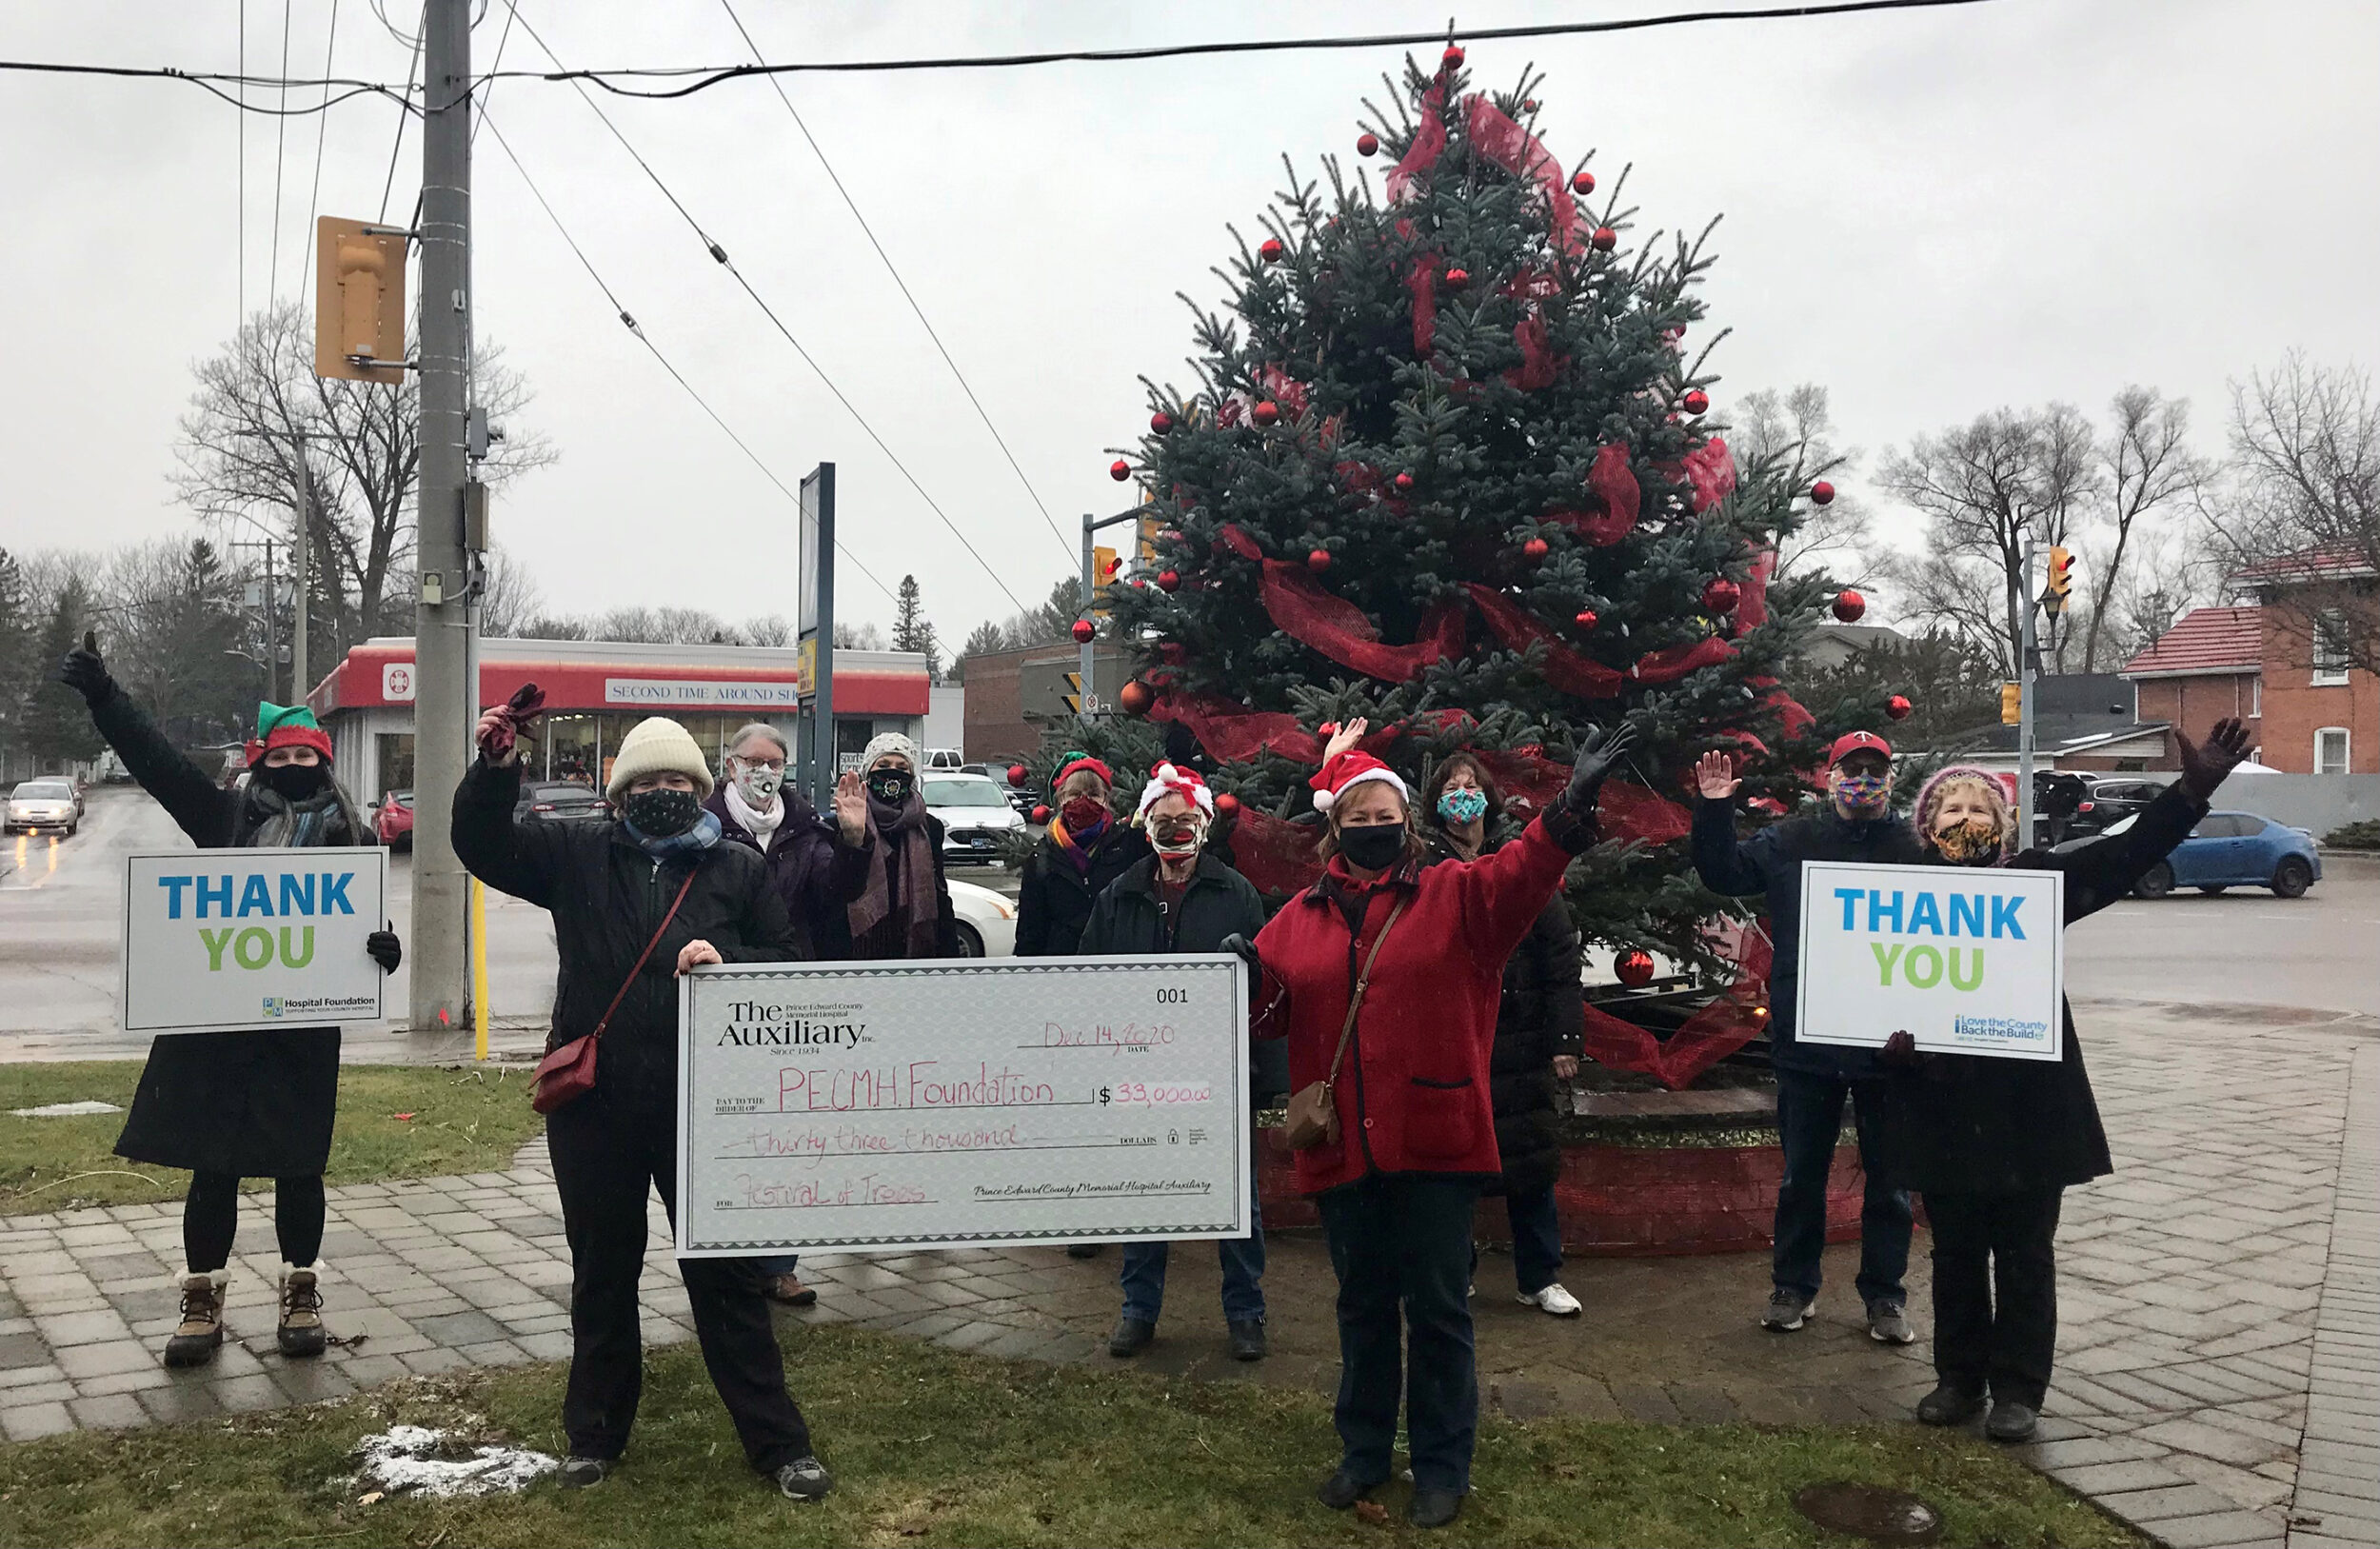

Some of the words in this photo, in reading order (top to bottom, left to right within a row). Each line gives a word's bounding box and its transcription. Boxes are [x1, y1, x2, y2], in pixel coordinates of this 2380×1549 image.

[612, 685, 671, 698] SECOND
[675, 687, 709, 699] TIME
[715, 688, 773, 701] AROUND
[158, 872, 355, 919] THANK
[1835, 887, 2027, 940] THANK
[198, 925, 314, 971] YOU
[1870, 942, 1984, 992] YOU
[285, 998, 323, 1008] Hospital
[324, 996, 375, 1006] Foundation
[1156, 988, 1188, 1003] 001
[728, 1001, 783, 1023] The
[839, 1003, 863, 1011] County
[717, 1020, 866, 1050] Auxiliary
[1045, 1023, 1086, 1047] Dec
[1961, 1016, 1987, 1026] Love
[1988, 1018, 2006, 1027] the
[2007, 1019, 2048, 1032] County
[1961, 1025, 1987, 1036] Back
[1988, 1027, 2006, 1037] the
[2007, 1028, 2034, 1040] Build
[909, 1062, 1053, 1107] Foundation
[1099, 1085, 1111, 1106] $
[746, 1127, 826, 1169] thirty
[834, 1125, 896, 1151] three
[900, 1123, 1021, 1149] thousand
[1120, 1136, 1157, 1144] DOLLARS
[838, 1180, 853, 1205] of
[974, 1186, 1002, 1196] Prince
[1004, 1184, 1042, 1196] Edward
[1043, 1183, 1074, 1198] County
[1076, 1182, 1125, 1193] Memorial
[1124, 1181, 1164, 1194] Hospital
[1165, 1180, 1211, 1193] Auxiliary
